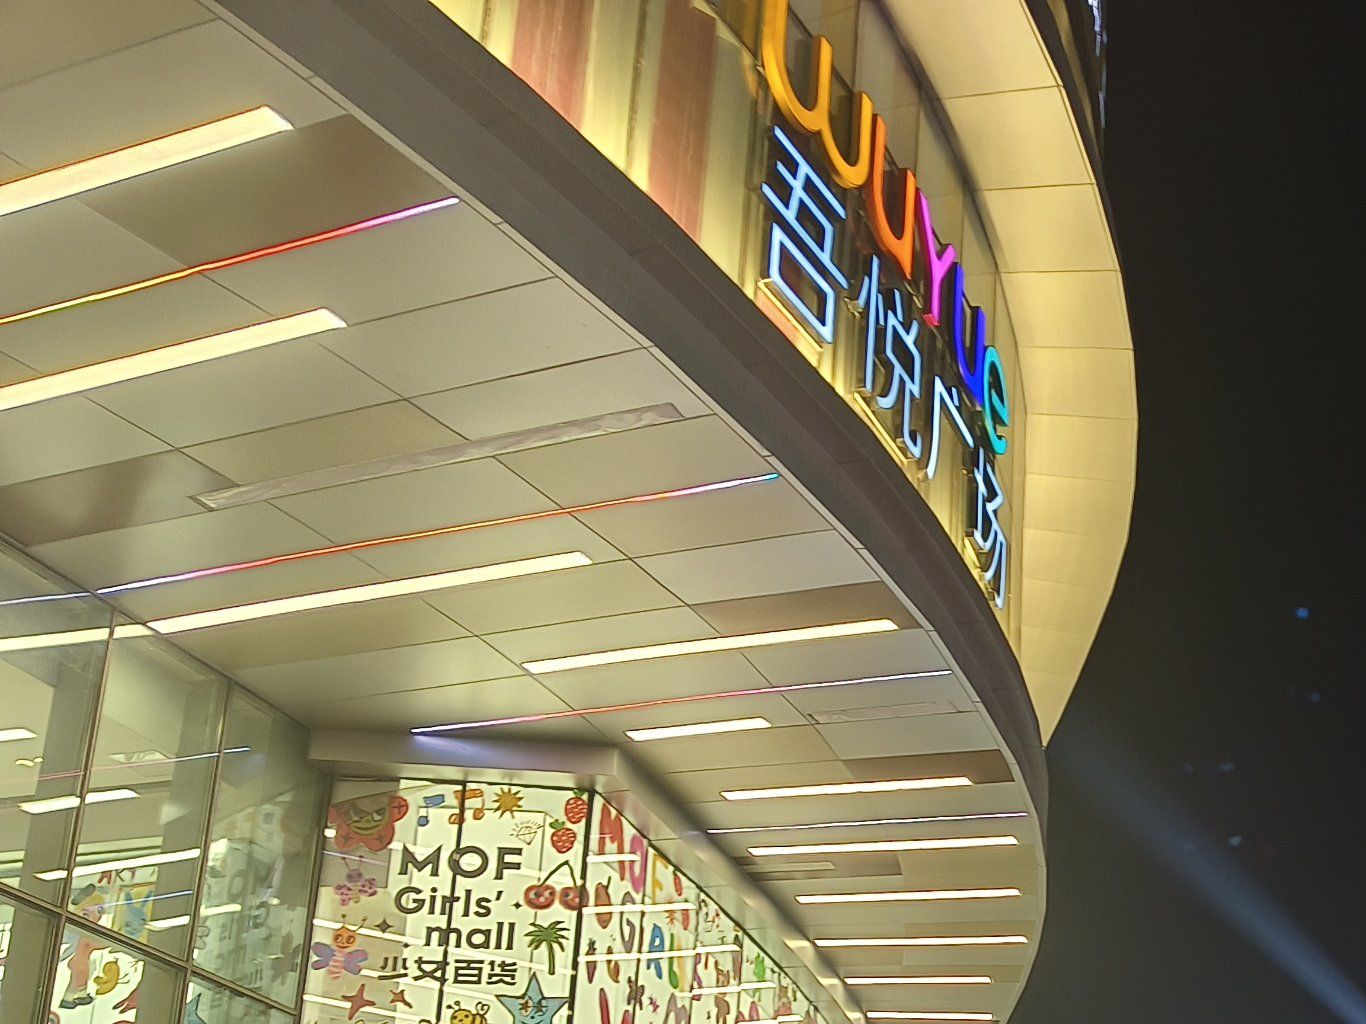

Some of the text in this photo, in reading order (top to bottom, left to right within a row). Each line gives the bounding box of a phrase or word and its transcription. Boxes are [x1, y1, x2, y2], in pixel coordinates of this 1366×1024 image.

[761, 125, 1006, 610] 吾悦广场
[398, 844, 523, 880] MOF
[424, 922, 516, 950] mall
[378, 956, 517, 985] 少女百货
